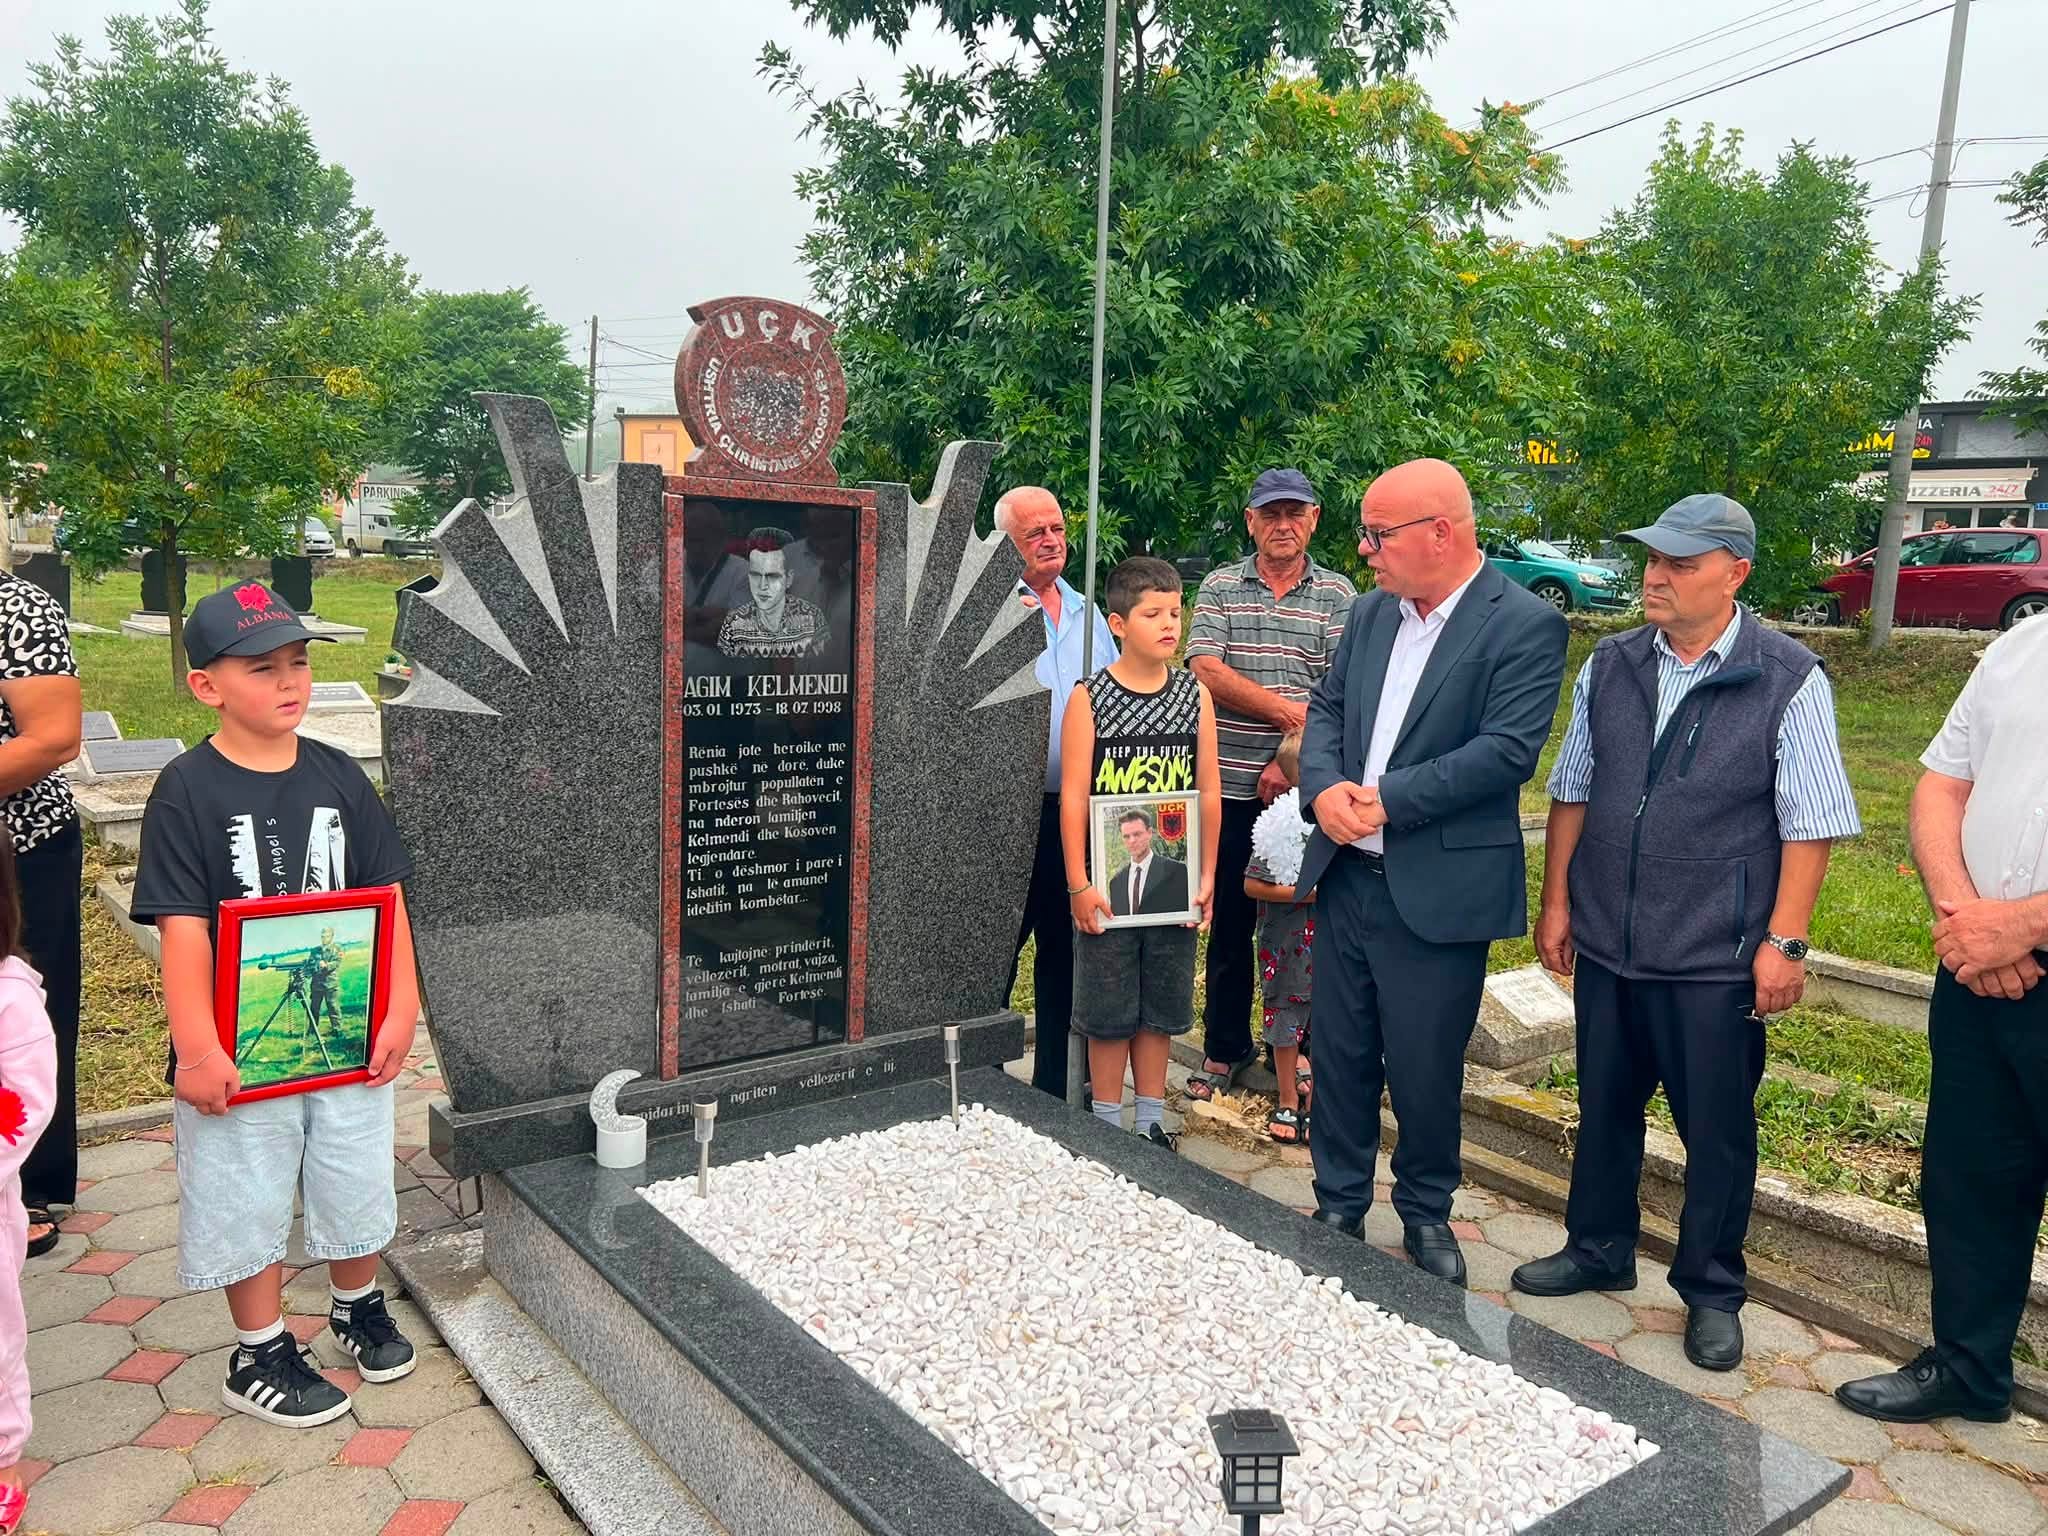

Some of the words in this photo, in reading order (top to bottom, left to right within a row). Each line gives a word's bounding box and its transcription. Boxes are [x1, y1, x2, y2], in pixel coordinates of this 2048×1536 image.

[719, 310, 817, 351] UÇK
[703, 357, 722, 435] USHTRIA
[1908, 486, 1982, 497] IZZERIA
[236, 611, 293, 632] ALBANIA
[683, 675, 731, 698] AGIM
[747, 673, 849, 697] KELMENDI
[688, 744, 727, 759] Rënia
[738, 743, 762, 759] jote
[828, 742, 847, 752] me
[1105, 746, 1131, 758] KEEP
[1135, 746, 1155, 757] THE
[689, 763, 738, 780] pushkë
[752, 761, 769, 774] në
[816, 757, 845, 770] duke
[1095, 754, 1195, 794] AWESOME
[689, 780, 748, 795] mbrojtur
[761, 775, 825, 792] popullatën
[835, 775, 844, 785] e
[688, 796, 750, 812] Fortesës
[755, 795, 778, 808] dhe
[1158, 803, 1185, 813] UÇK
[688, 816, 705, 829] na
[714, 815, 761, 828] nderon
[688, 830, 750, 847] Kelmendi
[757, 829, 780, 841] dhe
[714, 868, 723, 879] o
[732, 862, 789, 878] dëshmor
[795, 858, 800, 871] i
[838, 853, 843, 867] i
[738, 882, 753, 894] na
[783, 872, 828, 888] amanet
[738, 984, 747, 994] e
[789, 966, 843, 985] Kelmendi
[685, 1007, 709, 1020] dhe
[865, 1066, 873, 1077] e
